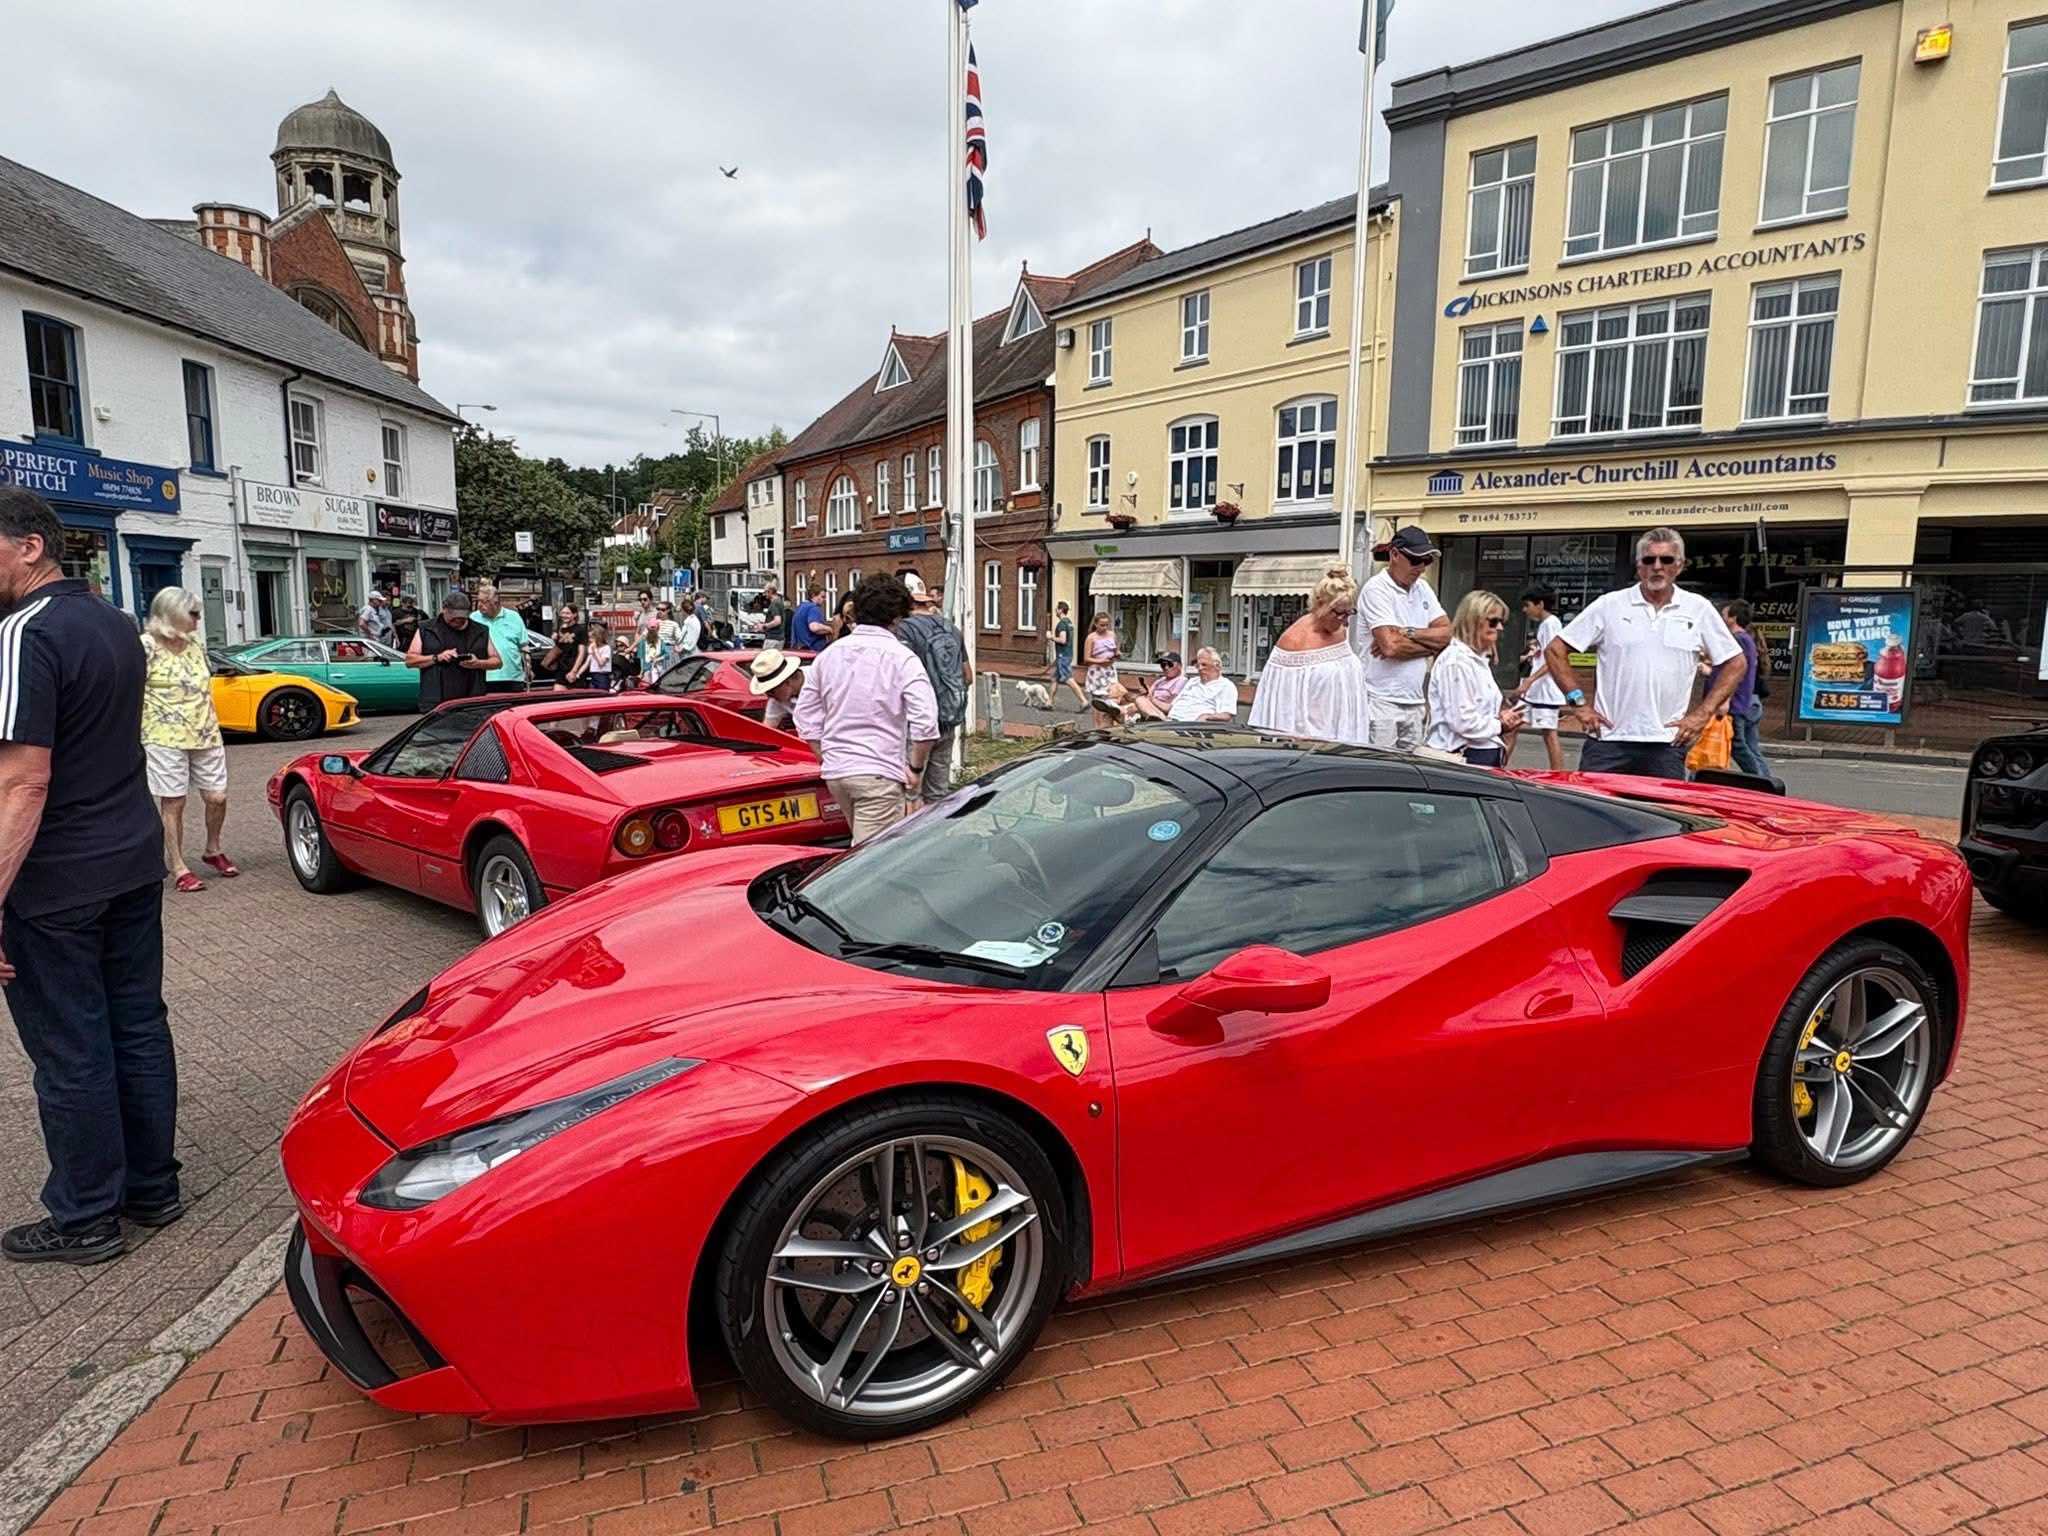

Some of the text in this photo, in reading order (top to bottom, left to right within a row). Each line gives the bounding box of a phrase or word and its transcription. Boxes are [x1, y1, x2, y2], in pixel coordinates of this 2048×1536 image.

[1472, 232, 1866, 310] DICKINSONS CHARTERED ACCOUNTANTS
[4, 449, 78, 476] PERFECT
[1470, 451, 1837, 490] Alexander-Churchill Accountants
[14, 470, 68, 492] PITCH
[88, 463, 154, 489] Music Shop
[256, 486, 300, 507] BROWN
[324, 497, 360, 516] SUGAR
[1472, 513, 1500, 522] 01494
[1628, 503, 1789, 516] www.alexander-churchill.com
[1537, 555, 1610, 565] DICKINSONS
[1739, 554, 1798, 567] THE
[1853, 615, 1891, 627] YOU'RE
[1828, 626, 1891, 643] TALKING
[739, 798, 800, 827] GTS 4W
